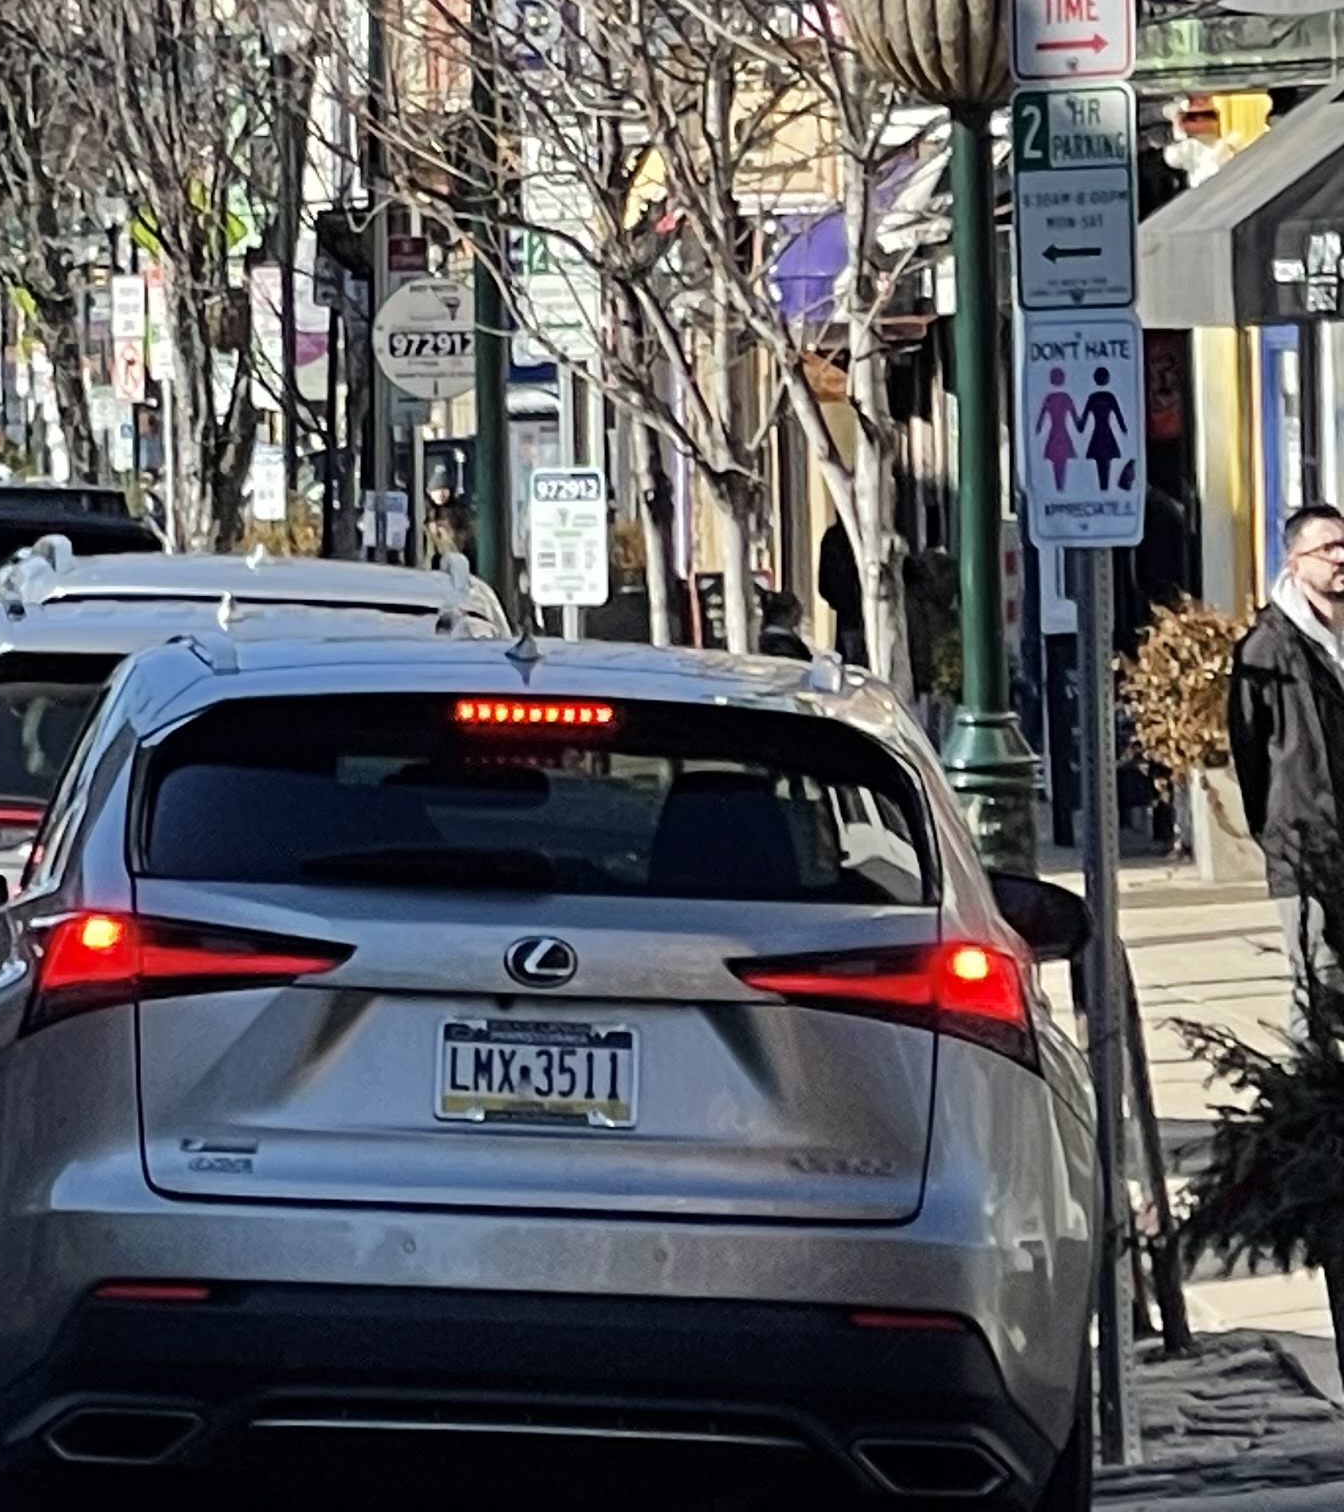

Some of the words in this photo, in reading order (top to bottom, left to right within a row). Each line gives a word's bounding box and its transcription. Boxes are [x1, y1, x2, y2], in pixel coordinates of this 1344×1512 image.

[1022, 104, 1043, 159] 2
[1071, 98, 1101, 126] HR
[1053, 132, 1125, 162] PARKING
[1031, 341, 1079, 361] DON'T
[1085, 339, 1131, 360] HATE
[535, 1049, 619, 1100] 3511
